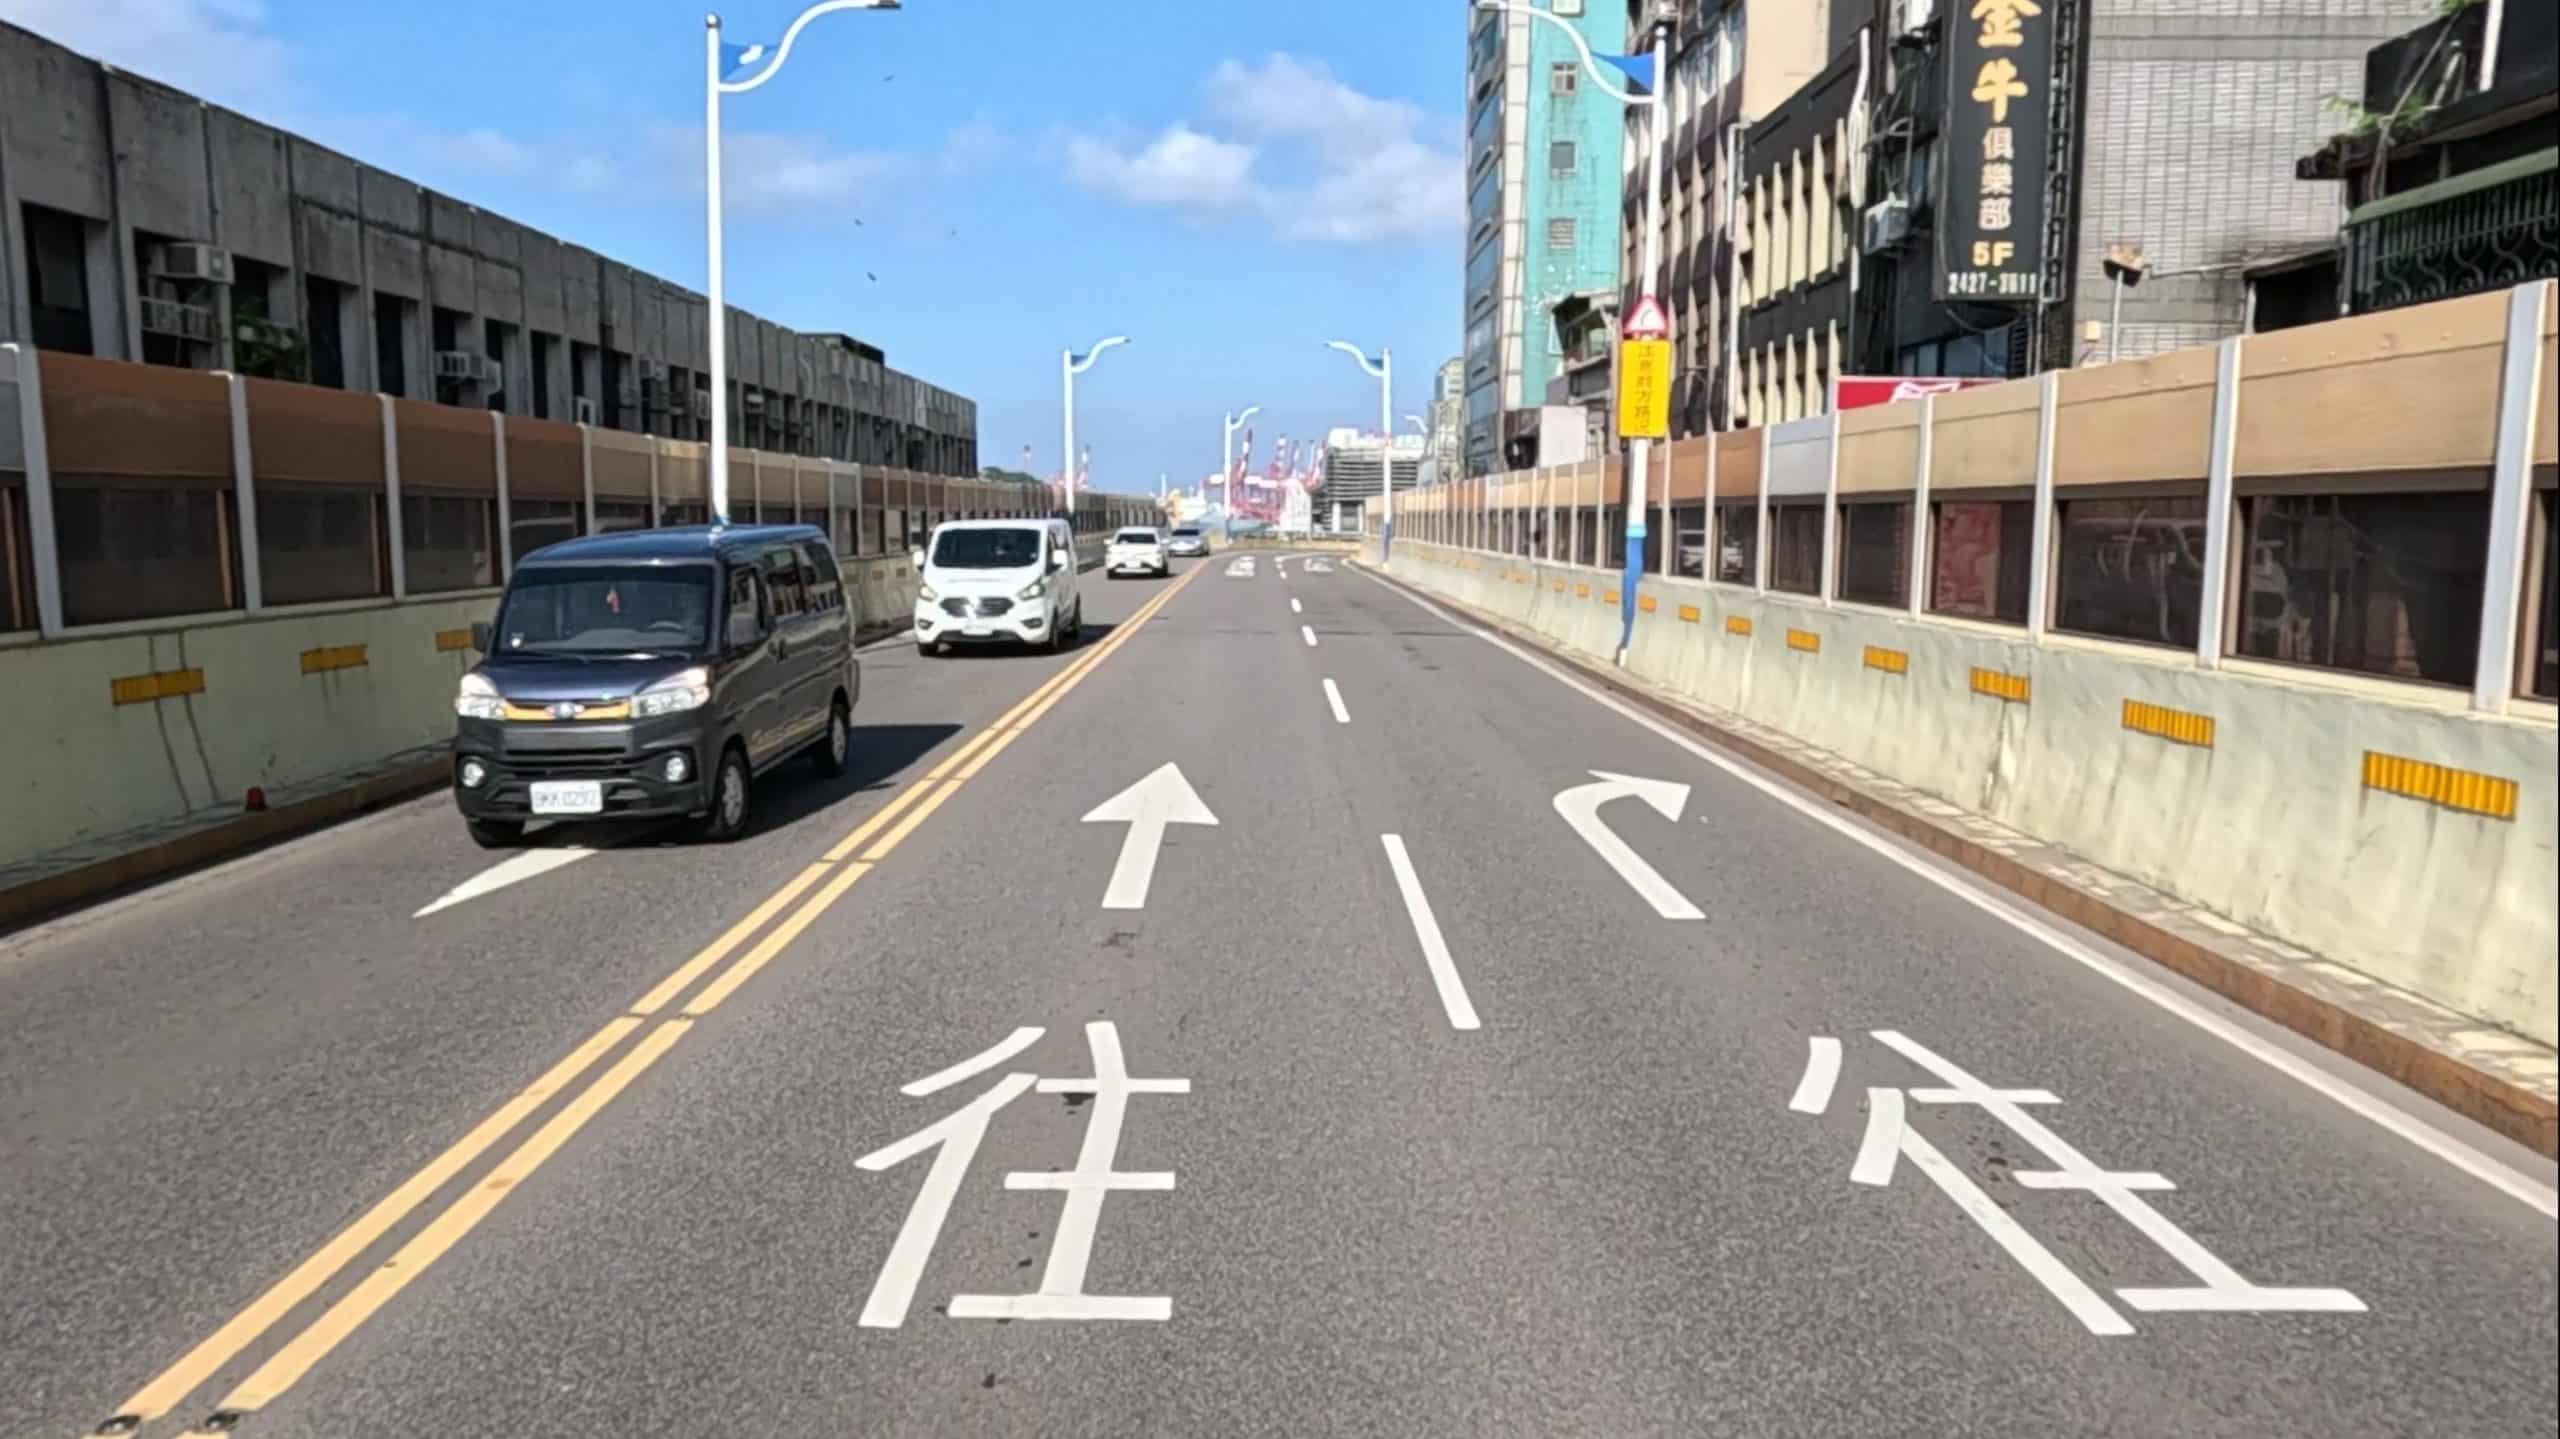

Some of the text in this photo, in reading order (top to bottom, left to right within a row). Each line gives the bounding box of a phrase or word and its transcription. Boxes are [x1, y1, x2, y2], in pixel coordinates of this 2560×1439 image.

[1972, 241, 2015, 267] 5F
[854, 1021, 1191, 1328] 往
[1789, 1030, 2368, 1335] 往
